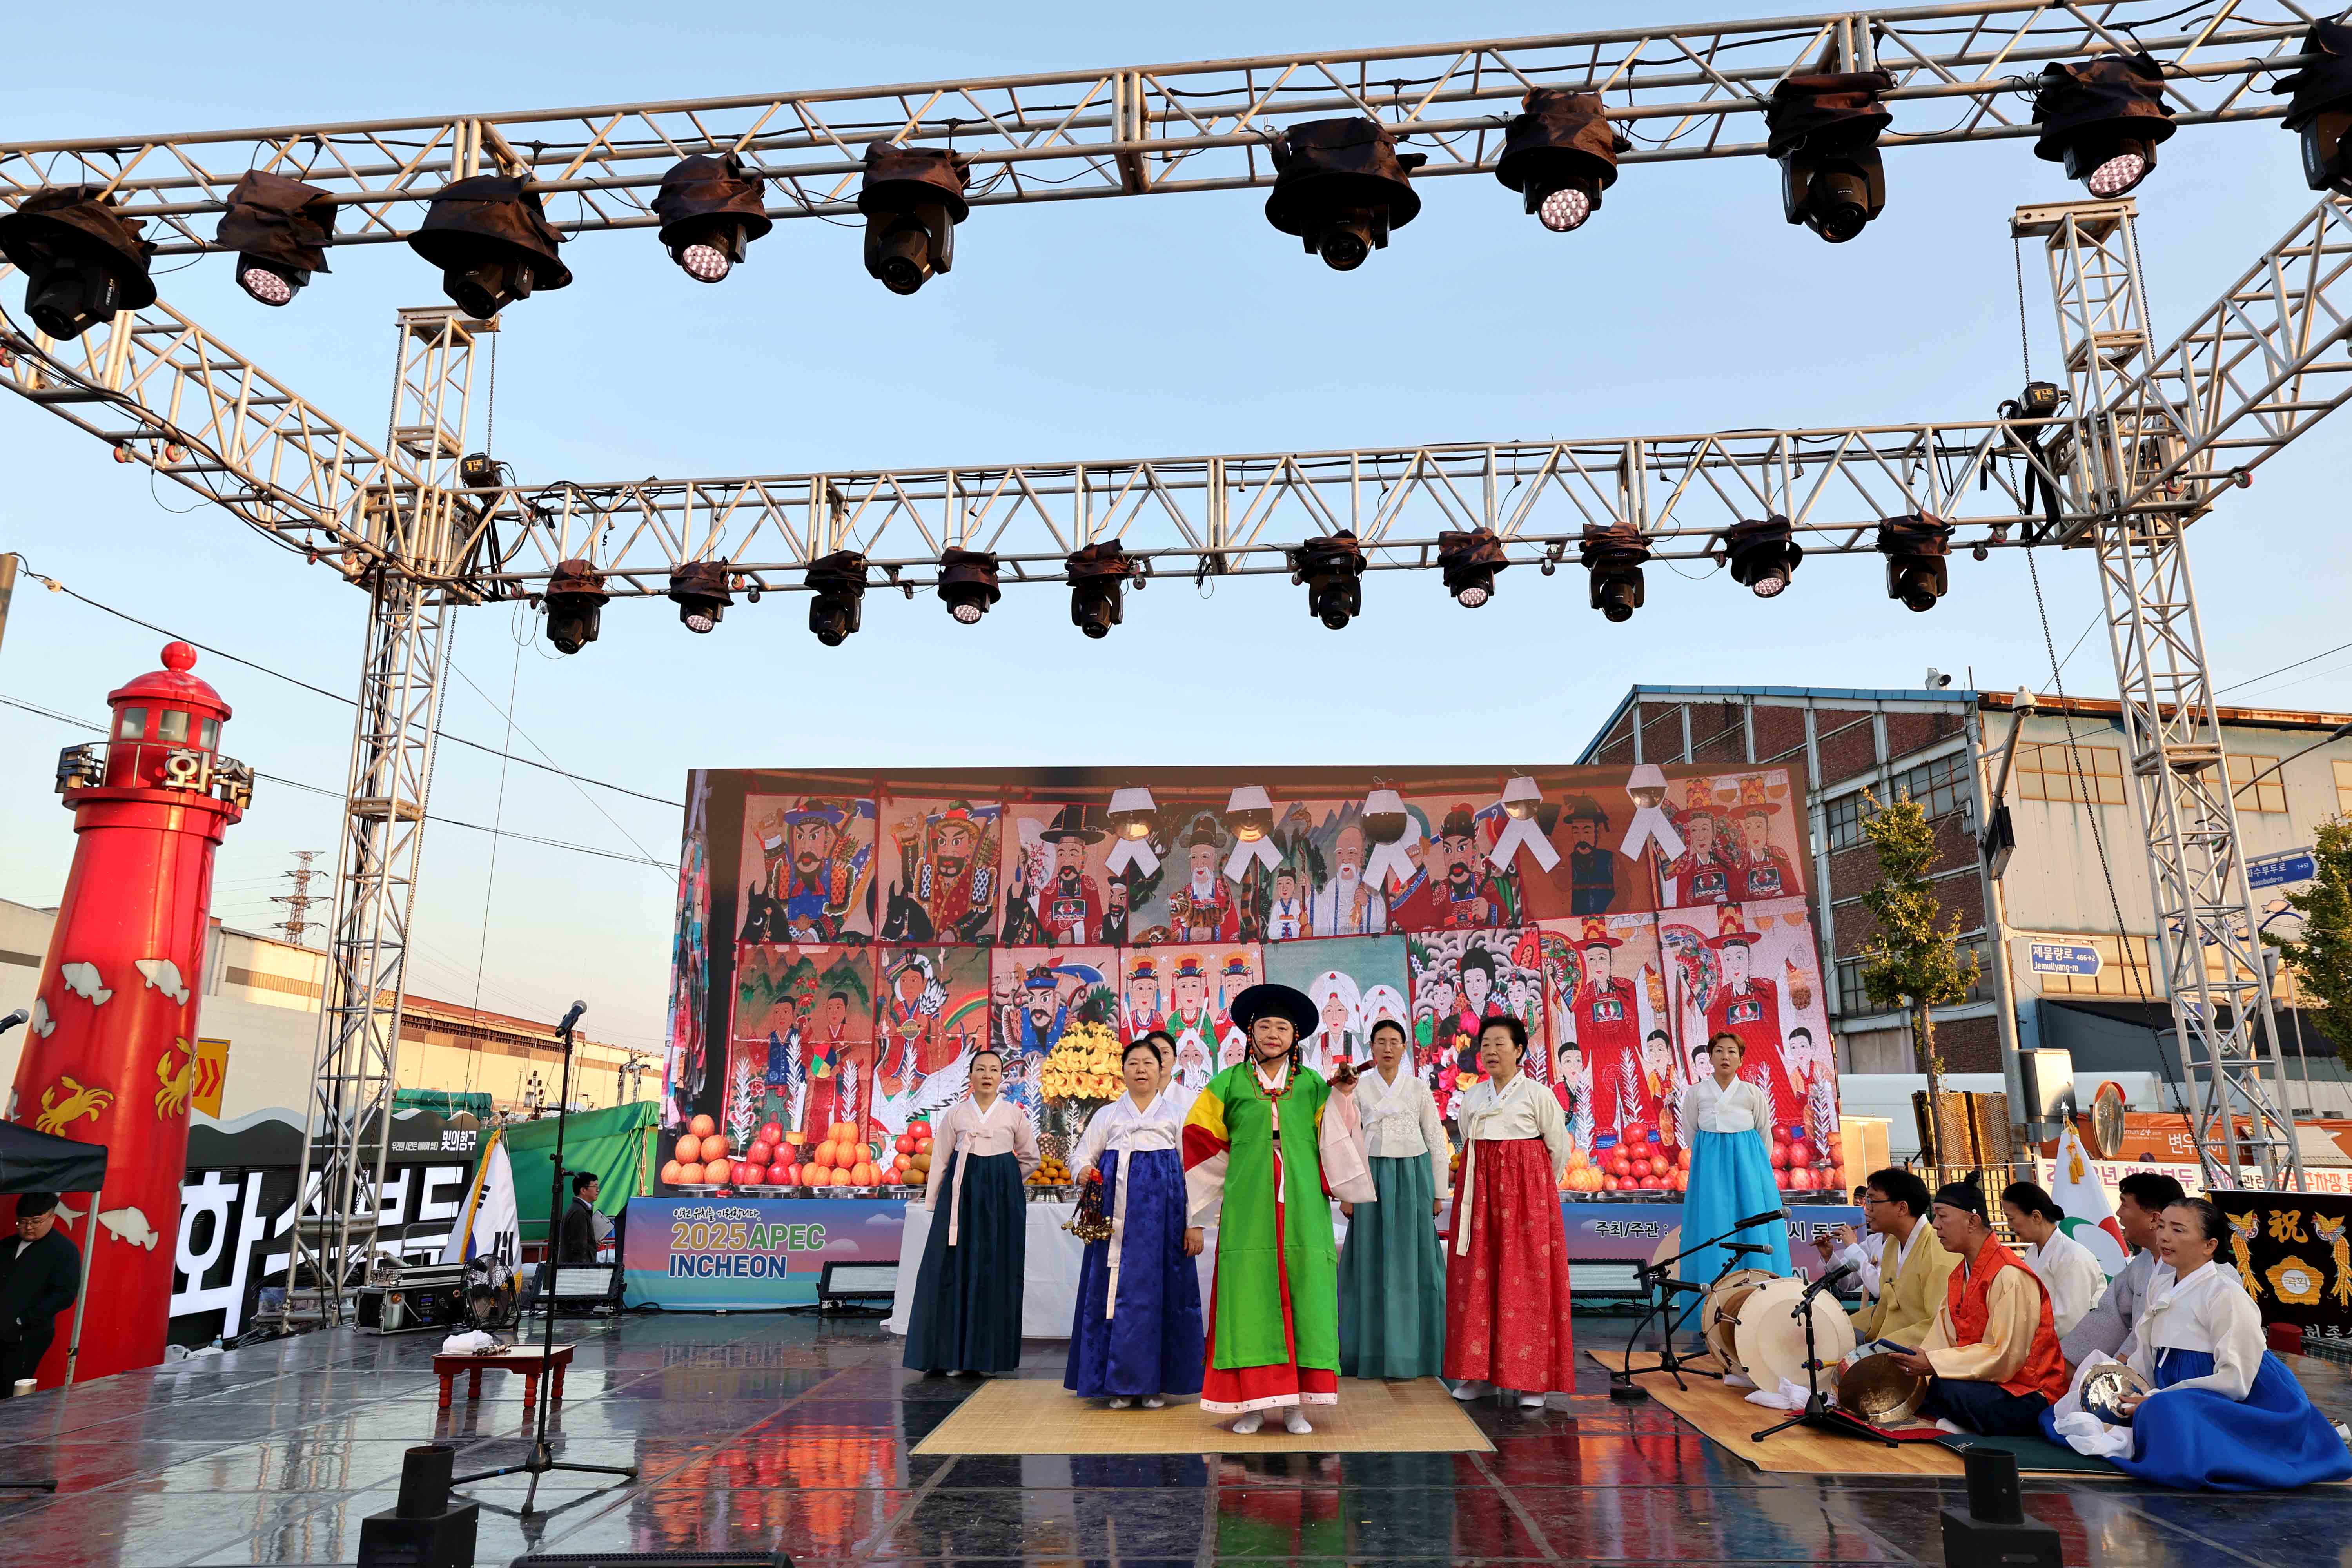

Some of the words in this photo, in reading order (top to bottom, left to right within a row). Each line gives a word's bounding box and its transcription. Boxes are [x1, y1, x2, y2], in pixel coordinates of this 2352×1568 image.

[2249, 876, 2283, 888] wasubudu-ro
[2033, 946, 2074, 961] 제물량로
[2034, 961, 2079, 973] Jemullyang-ro
[673, 1207, 691, 1220] 인천
[693, 1206, 715, 1222] 유치를
[2268, 1209, 2308, 1243] 祝
[671, 1222, 747, 1251] 2025
[747, 1223, 826, 1252] APEC
[668, 1254, 788, 1279] INCHEON
[2284, 1276, 2308, 1287] 국회
[2305, 1323, 2352, 1339] 허종
